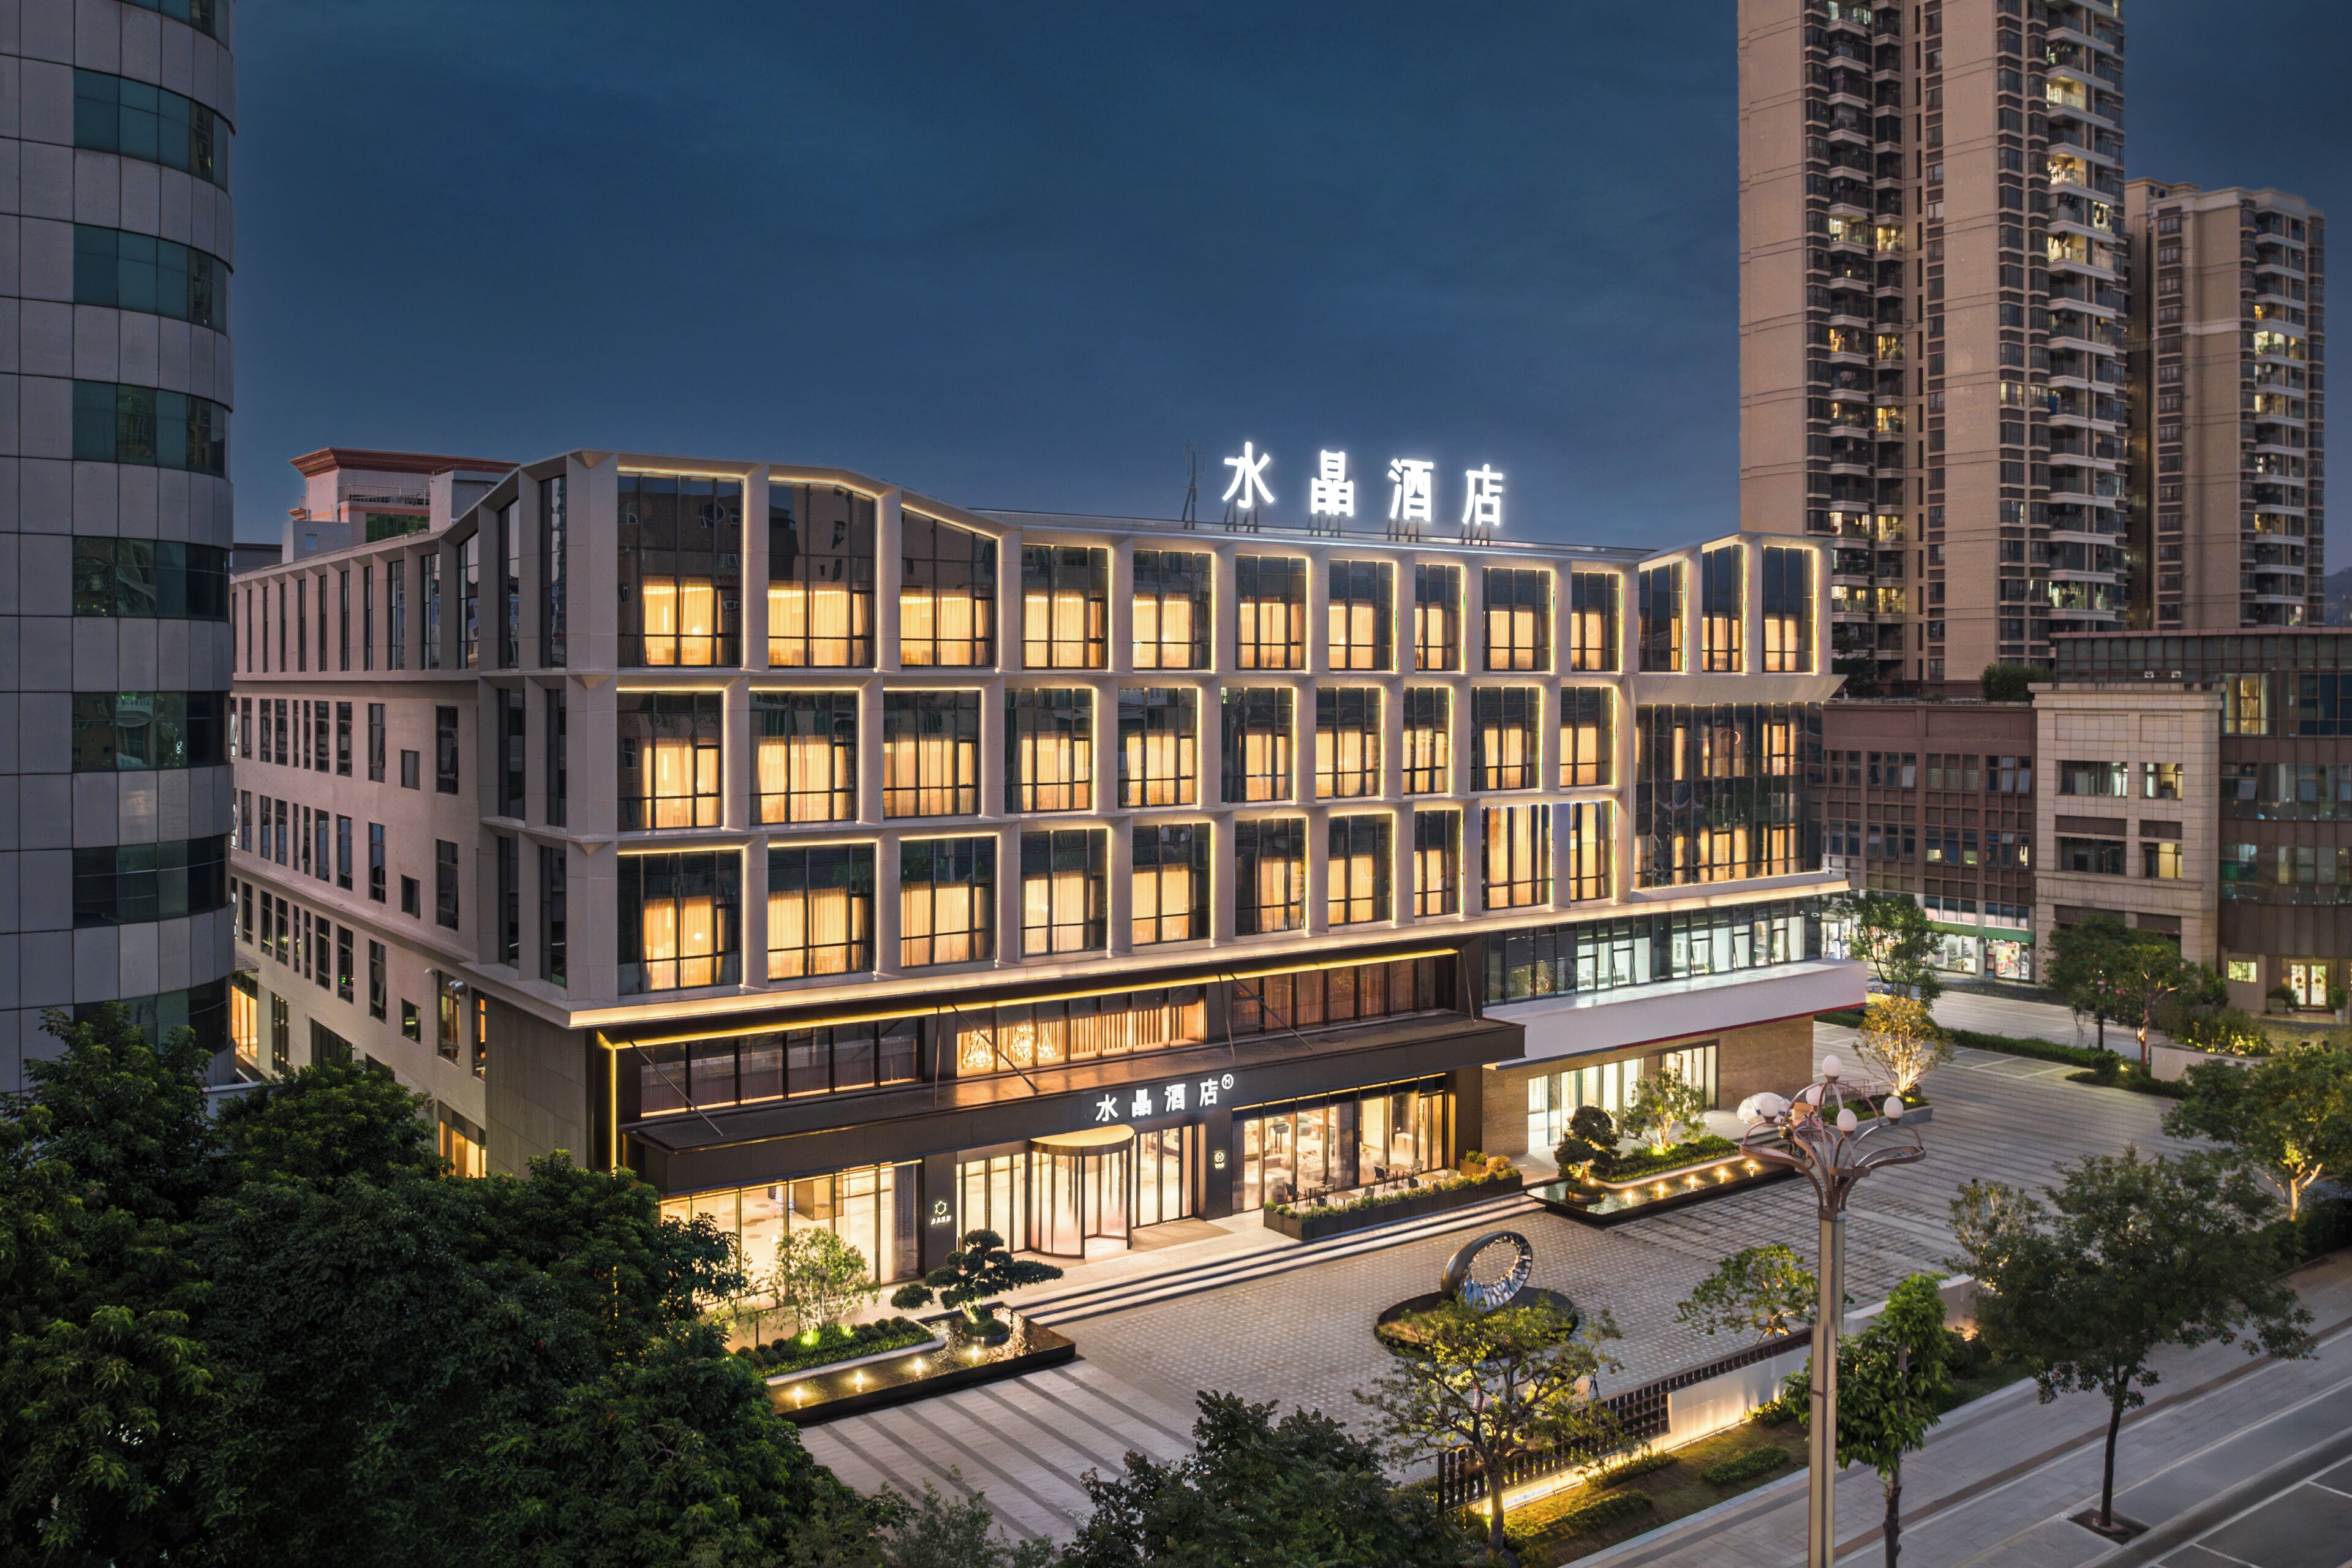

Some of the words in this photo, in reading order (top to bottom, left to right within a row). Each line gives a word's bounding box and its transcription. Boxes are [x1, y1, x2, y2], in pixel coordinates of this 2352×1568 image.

[1222, 442, 1503, 526] 水晶酒店
[1095, 1078, 1218, 1121] 水晶酒店
